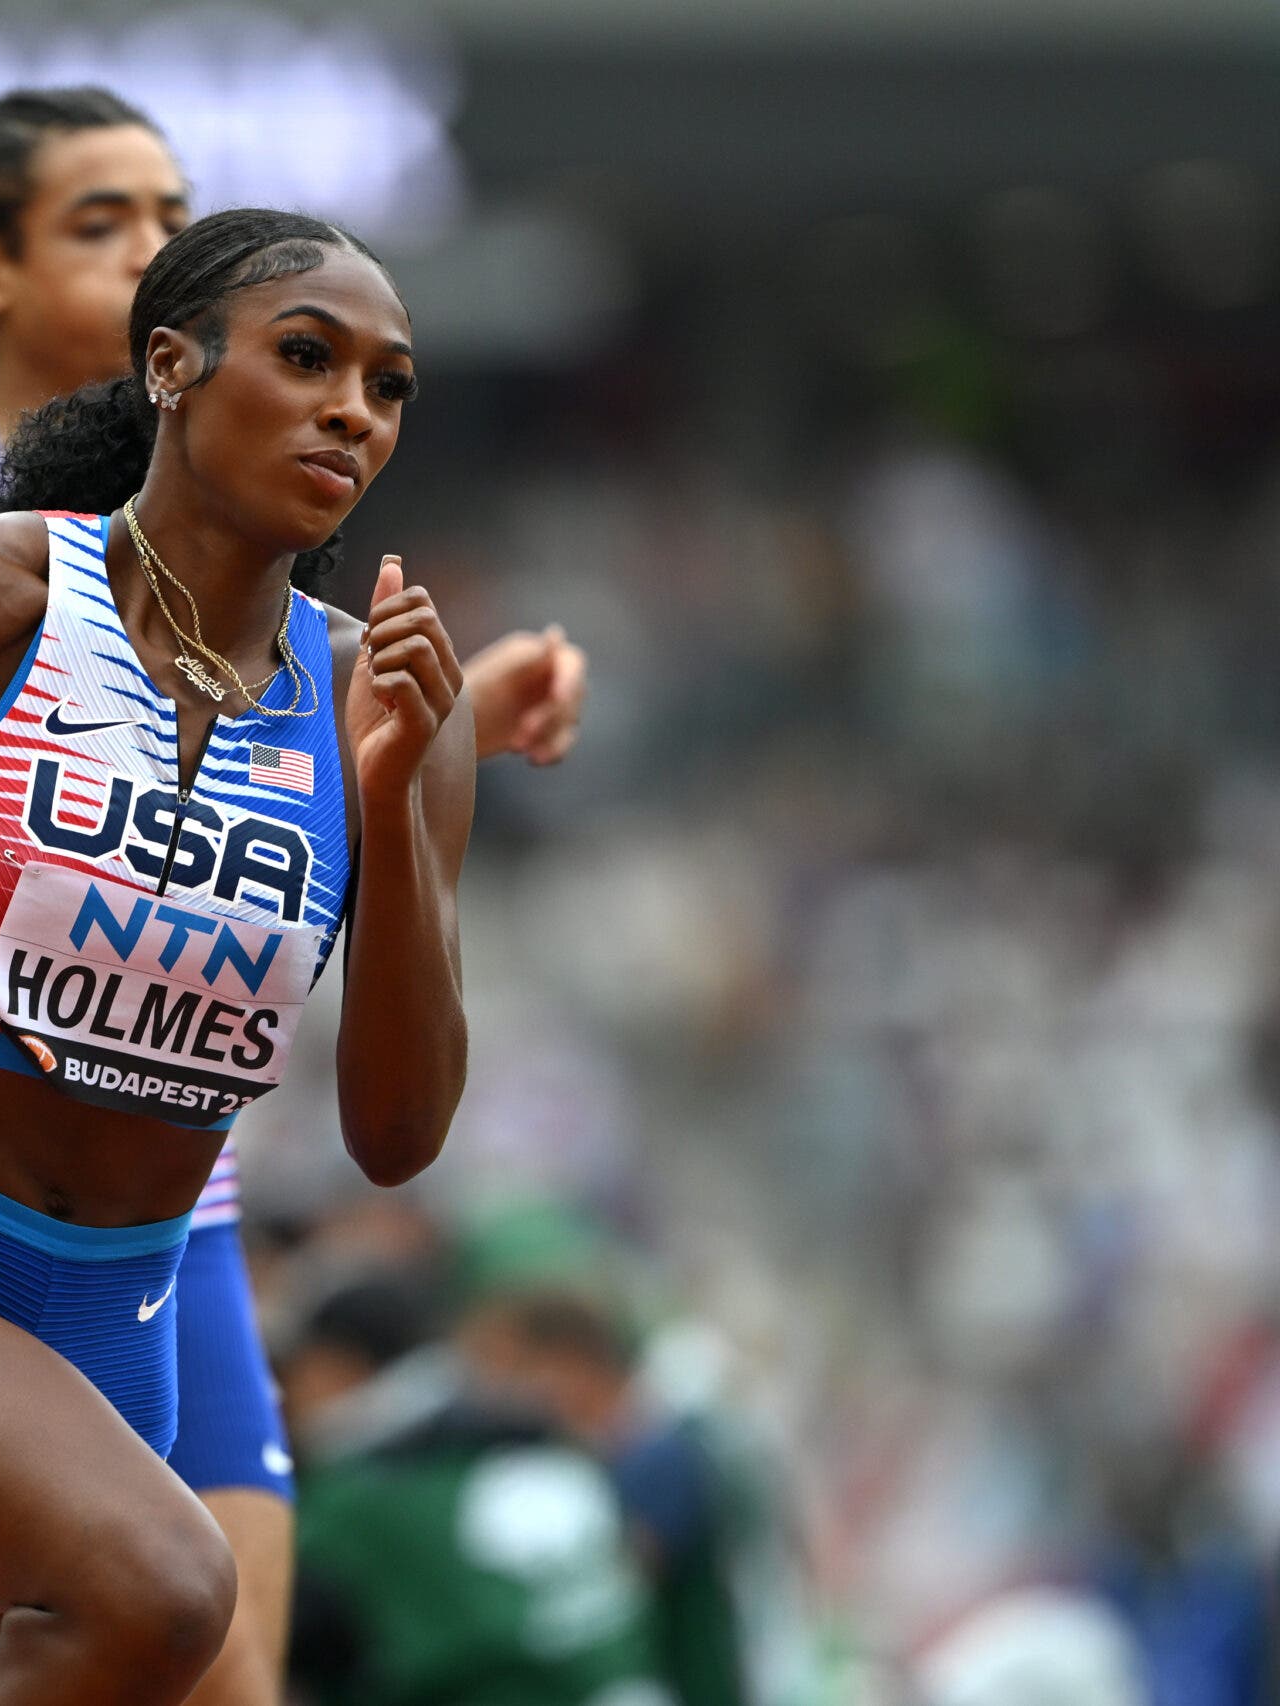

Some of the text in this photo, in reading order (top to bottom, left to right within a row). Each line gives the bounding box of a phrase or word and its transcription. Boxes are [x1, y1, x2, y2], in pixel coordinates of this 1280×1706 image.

[25, 757, 310, 924] USA
[69, 882, 283, 996] NTN
[7, 949, 279, 1072] HOLMES
[64, 1057, 220, 1111] BUDAPEST
